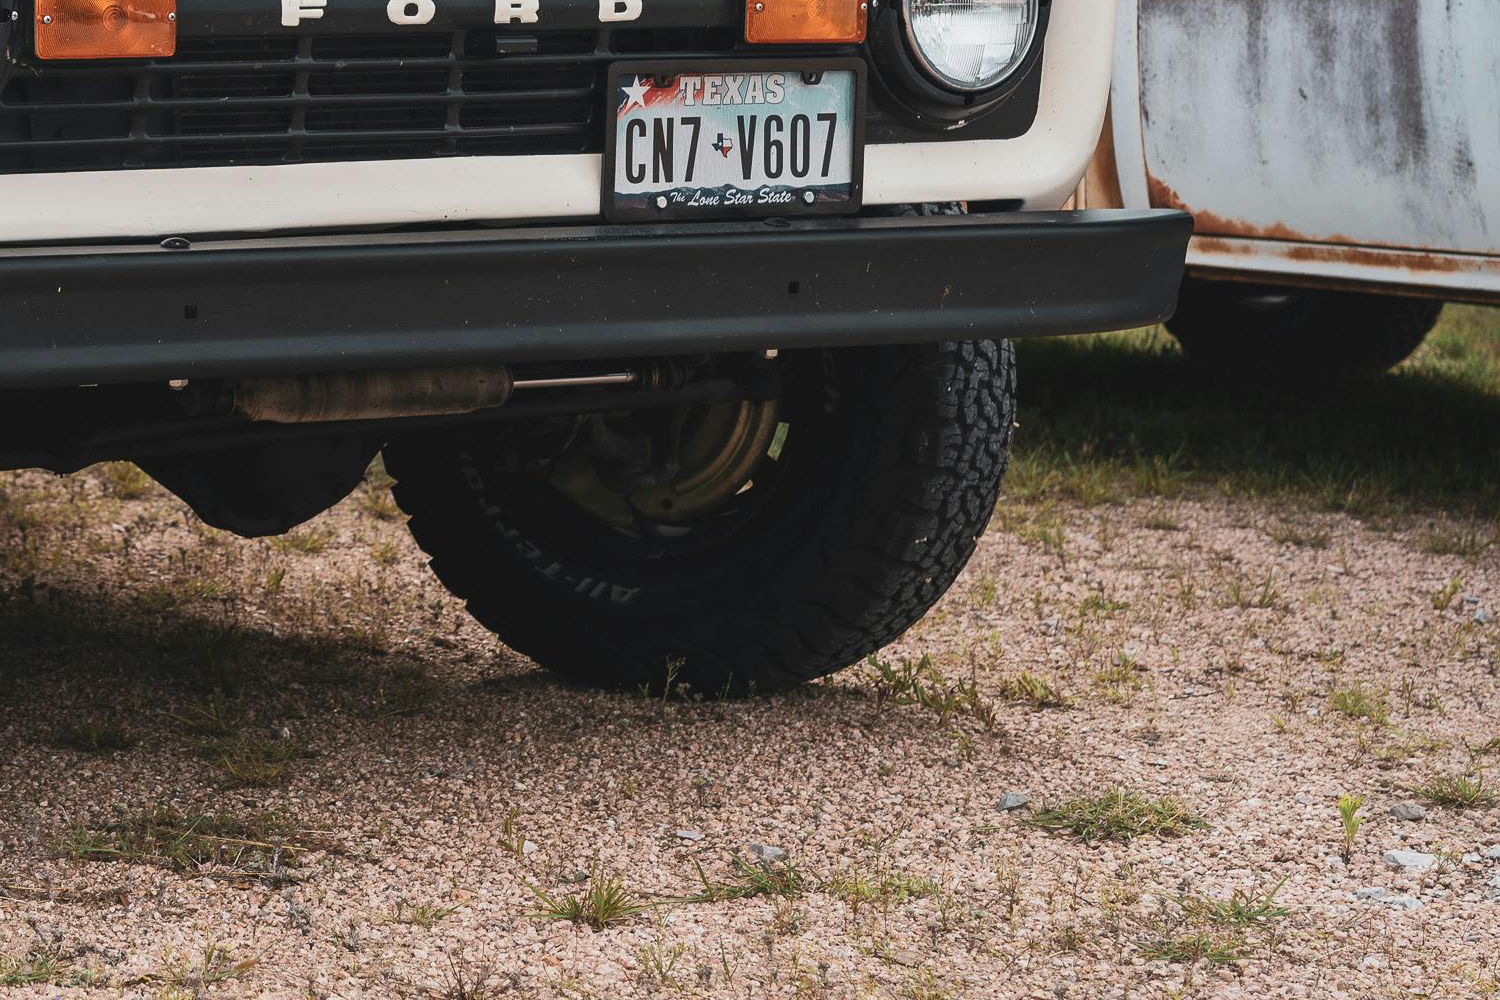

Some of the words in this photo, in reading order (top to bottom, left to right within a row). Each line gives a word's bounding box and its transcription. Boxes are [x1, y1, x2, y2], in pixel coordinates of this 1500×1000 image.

[679, 73, 786, 106] TEXAS
[625, 117, 701, 184] CN7
[737, 112, 838, 180] V607
[670, 191, 686, 203] The
[687, 190, 720, 206] Lone
[723, 188, 754, 205] Star
[757, 187, 792, 204] State
